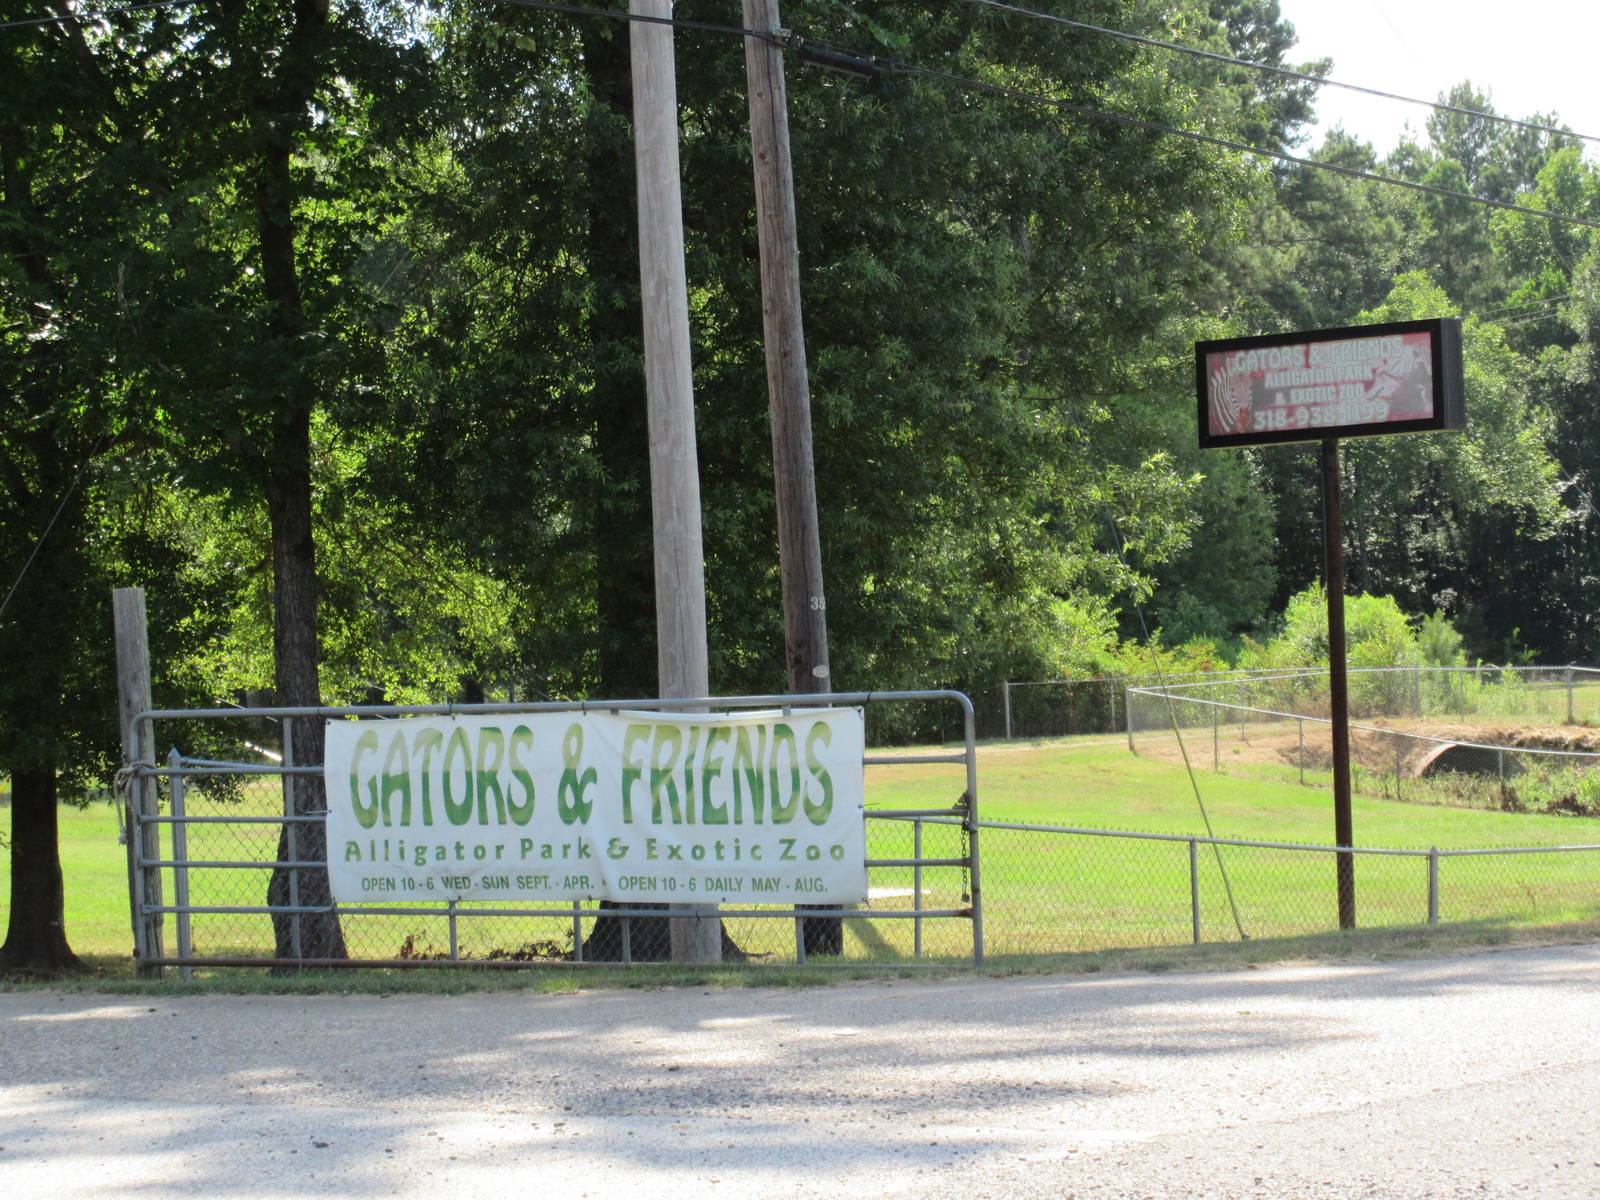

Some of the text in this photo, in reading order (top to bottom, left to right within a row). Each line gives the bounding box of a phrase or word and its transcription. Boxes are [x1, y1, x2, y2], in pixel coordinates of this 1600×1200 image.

[1235, 336, 1403, 370] GATORS & FRIENDS
[1266, 365, 1373, 389] ALLIGATOR PARK
[1291, 386, 1337, 403] EXOTIC
[1339, 383, 1364, 400] ZOO
[350, 721, 834, 829] GATORS & FRIENDS
[344, 836, 845, 866] Alligator Park & Exotic Zoo
[362, 876, 396, 892] OPEN
[441, 876, 471, 890] WED
[483, 876, 509, 889] SUN
[517, 876, 552, 890] SEPT.
[564, 875, 594, 889] APR.
[619, 877, 657, 891] OPEN
[705, 877, 743, 892] DAILY
[752, 878, 781, 892] MAY
[795, 878, 827, 892] AUG.
